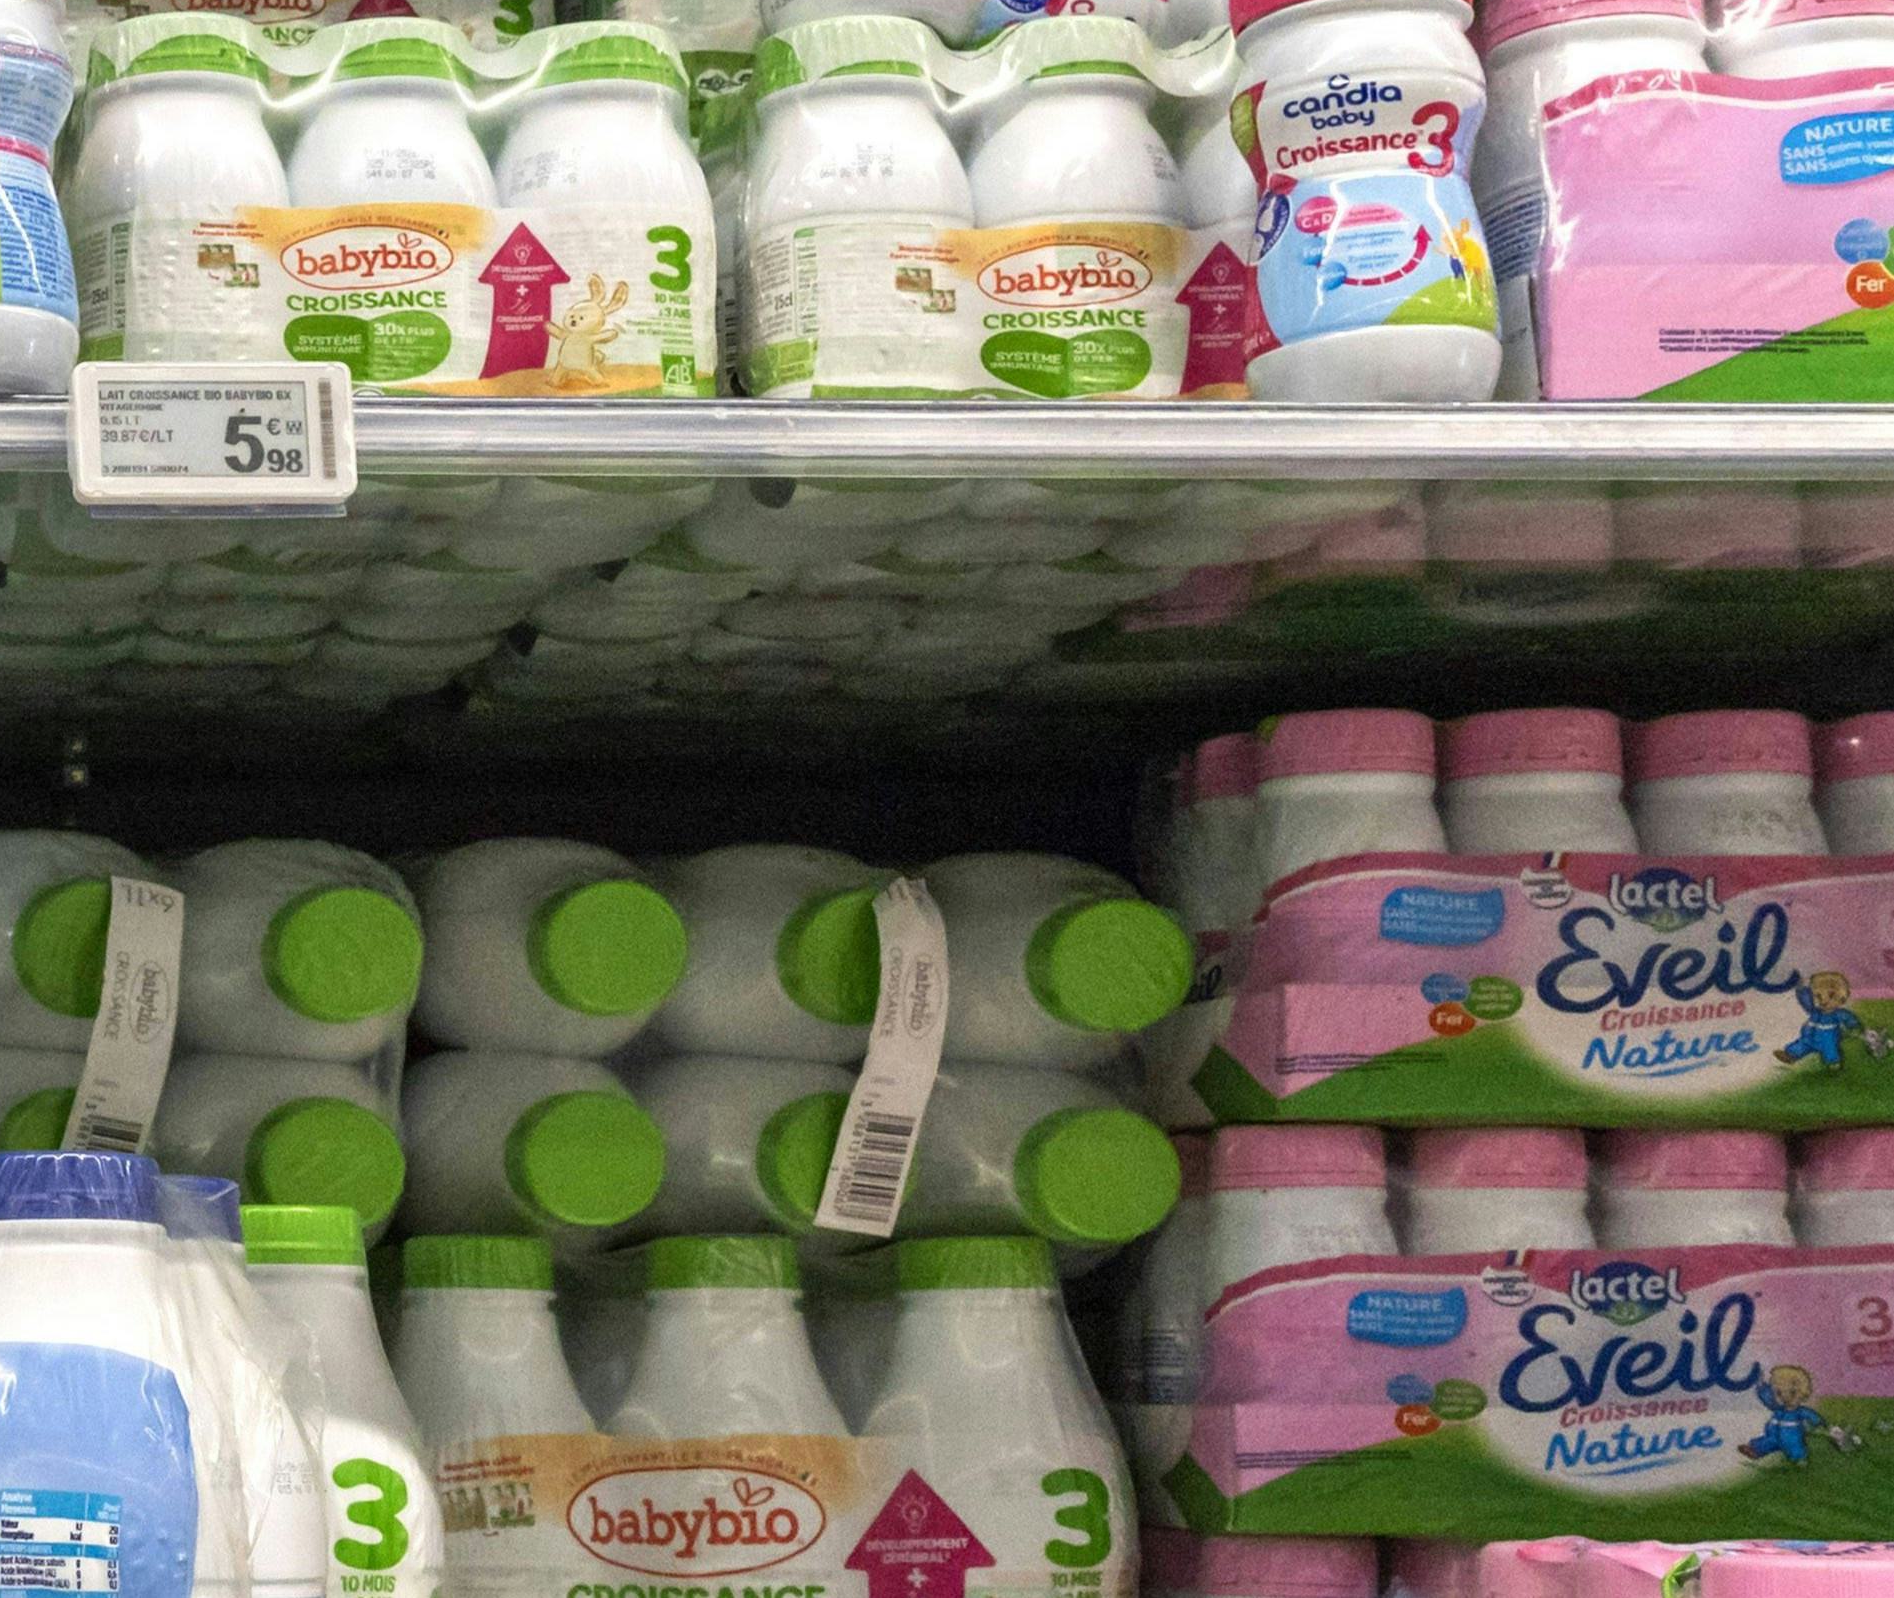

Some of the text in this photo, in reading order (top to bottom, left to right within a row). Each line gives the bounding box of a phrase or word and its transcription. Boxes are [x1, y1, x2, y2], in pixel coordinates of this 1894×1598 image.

[1282, 85, 1403, 120] candia
[1310, 109, 1375, 131] baby
[1275, 132, 1419, 171] Croissance
[1408, 101, 1461, 176] 3
[295, 241, 441, 286] babybio
[645, 224, 693, 292] 3
[286, 290, 447, 311] CROISSANCE
[99, 391, 124, 401] LAIT
[129, 391, 200, 401] CROISSANCE
[224, 416, 303, 473] 5 98
[1535, 902, 1804, 1015] Eveil
[1600, 999, 1746, 1032] Croissance
[1581, 1028, 1760, 1072] Nature
[1570, 1266, 1685, 1306] lactel
[589, 1496, 800, 1558] babybio
